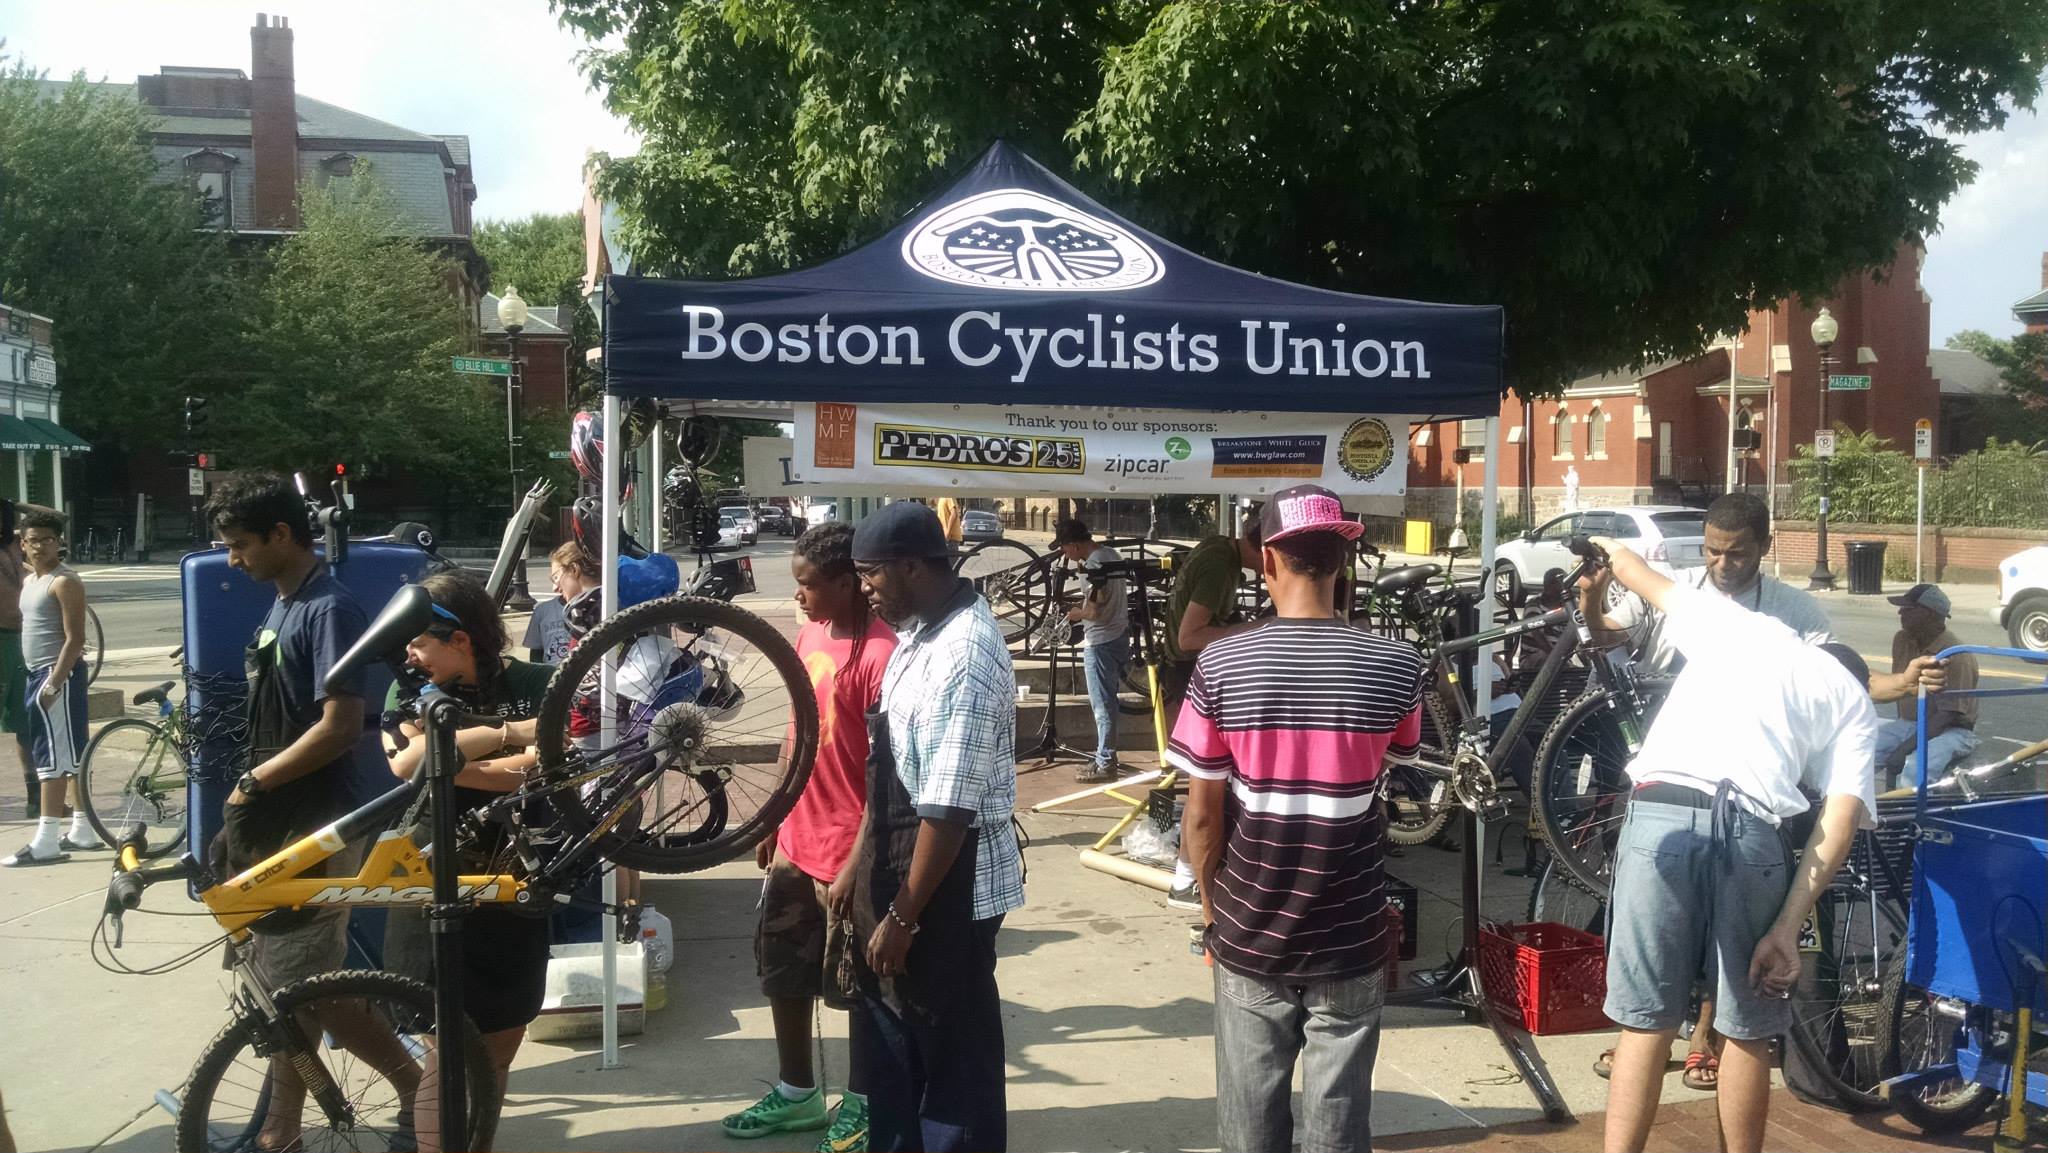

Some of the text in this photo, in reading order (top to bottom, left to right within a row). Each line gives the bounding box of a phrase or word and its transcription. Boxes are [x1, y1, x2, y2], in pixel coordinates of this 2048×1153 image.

[681, 305, 1432, 384] Boston Cyclists Union
[465, 360, 481, 371] BLUE
[482, 361, 496, 373] HILL
[1830, 377, 1862, 388] MAGAZINE
[1005, 413, 1219, 435] Thank you to our sponsors:
[880, 430, 1074, 469] PEDRO'S 25
[1233, 451, 1306, 461] www.bwglaw.com
[1104, 454, 1170, 477] zipcar
